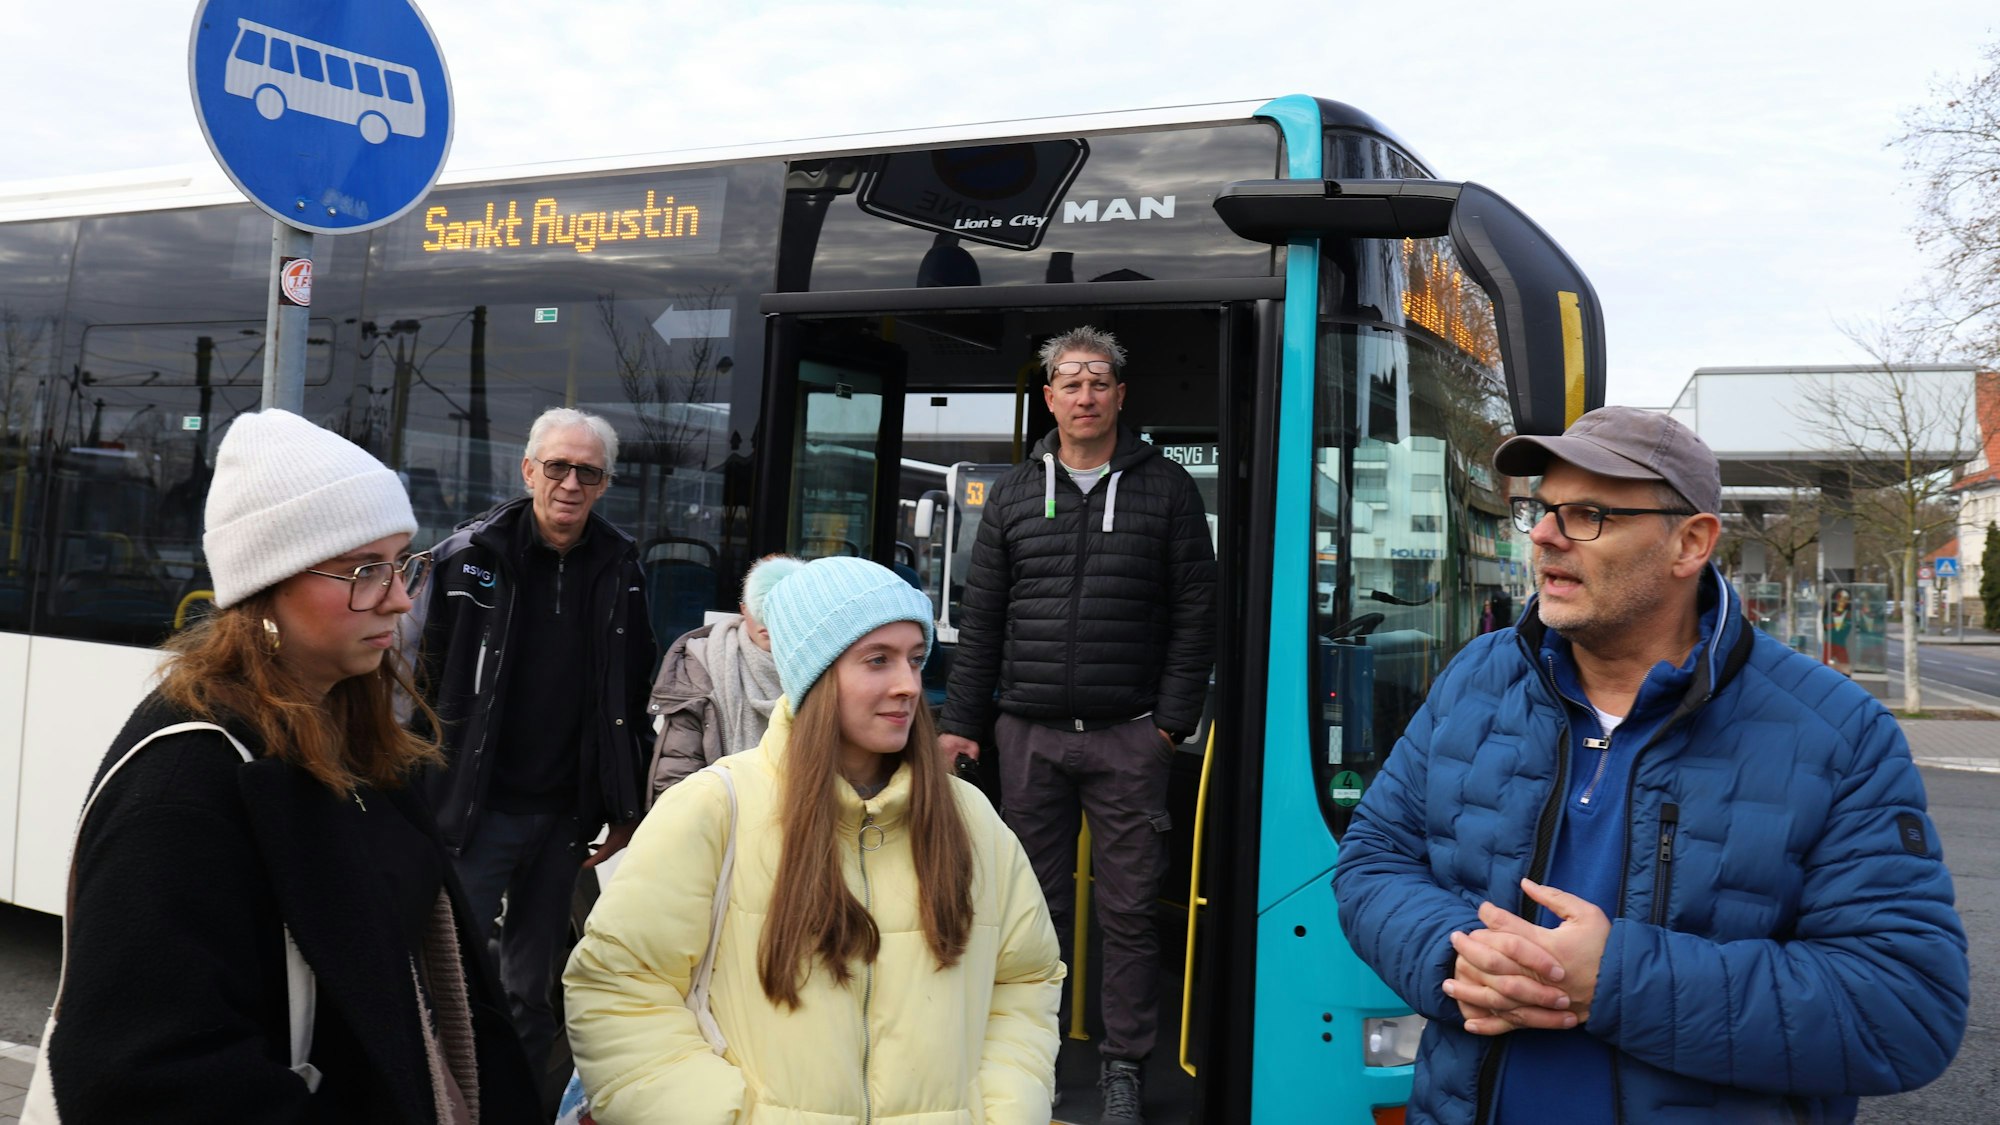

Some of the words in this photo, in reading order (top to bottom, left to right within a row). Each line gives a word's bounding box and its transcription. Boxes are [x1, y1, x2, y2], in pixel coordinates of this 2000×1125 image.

[1063, 195, 1176, 224] MAN
[423, 201, 522, 251] Sankt
[531, 190, 699, 253] Augustin
[953, 216, 1003, 230] Lion's
[1009, 214, 1048, 228] City
[1163, 446, 1203, 465] RSVG
[967, 482, 984, 505] 53
[463, 563, 491, 581] RSVG
[1343, 772, 1353, 789] 4
